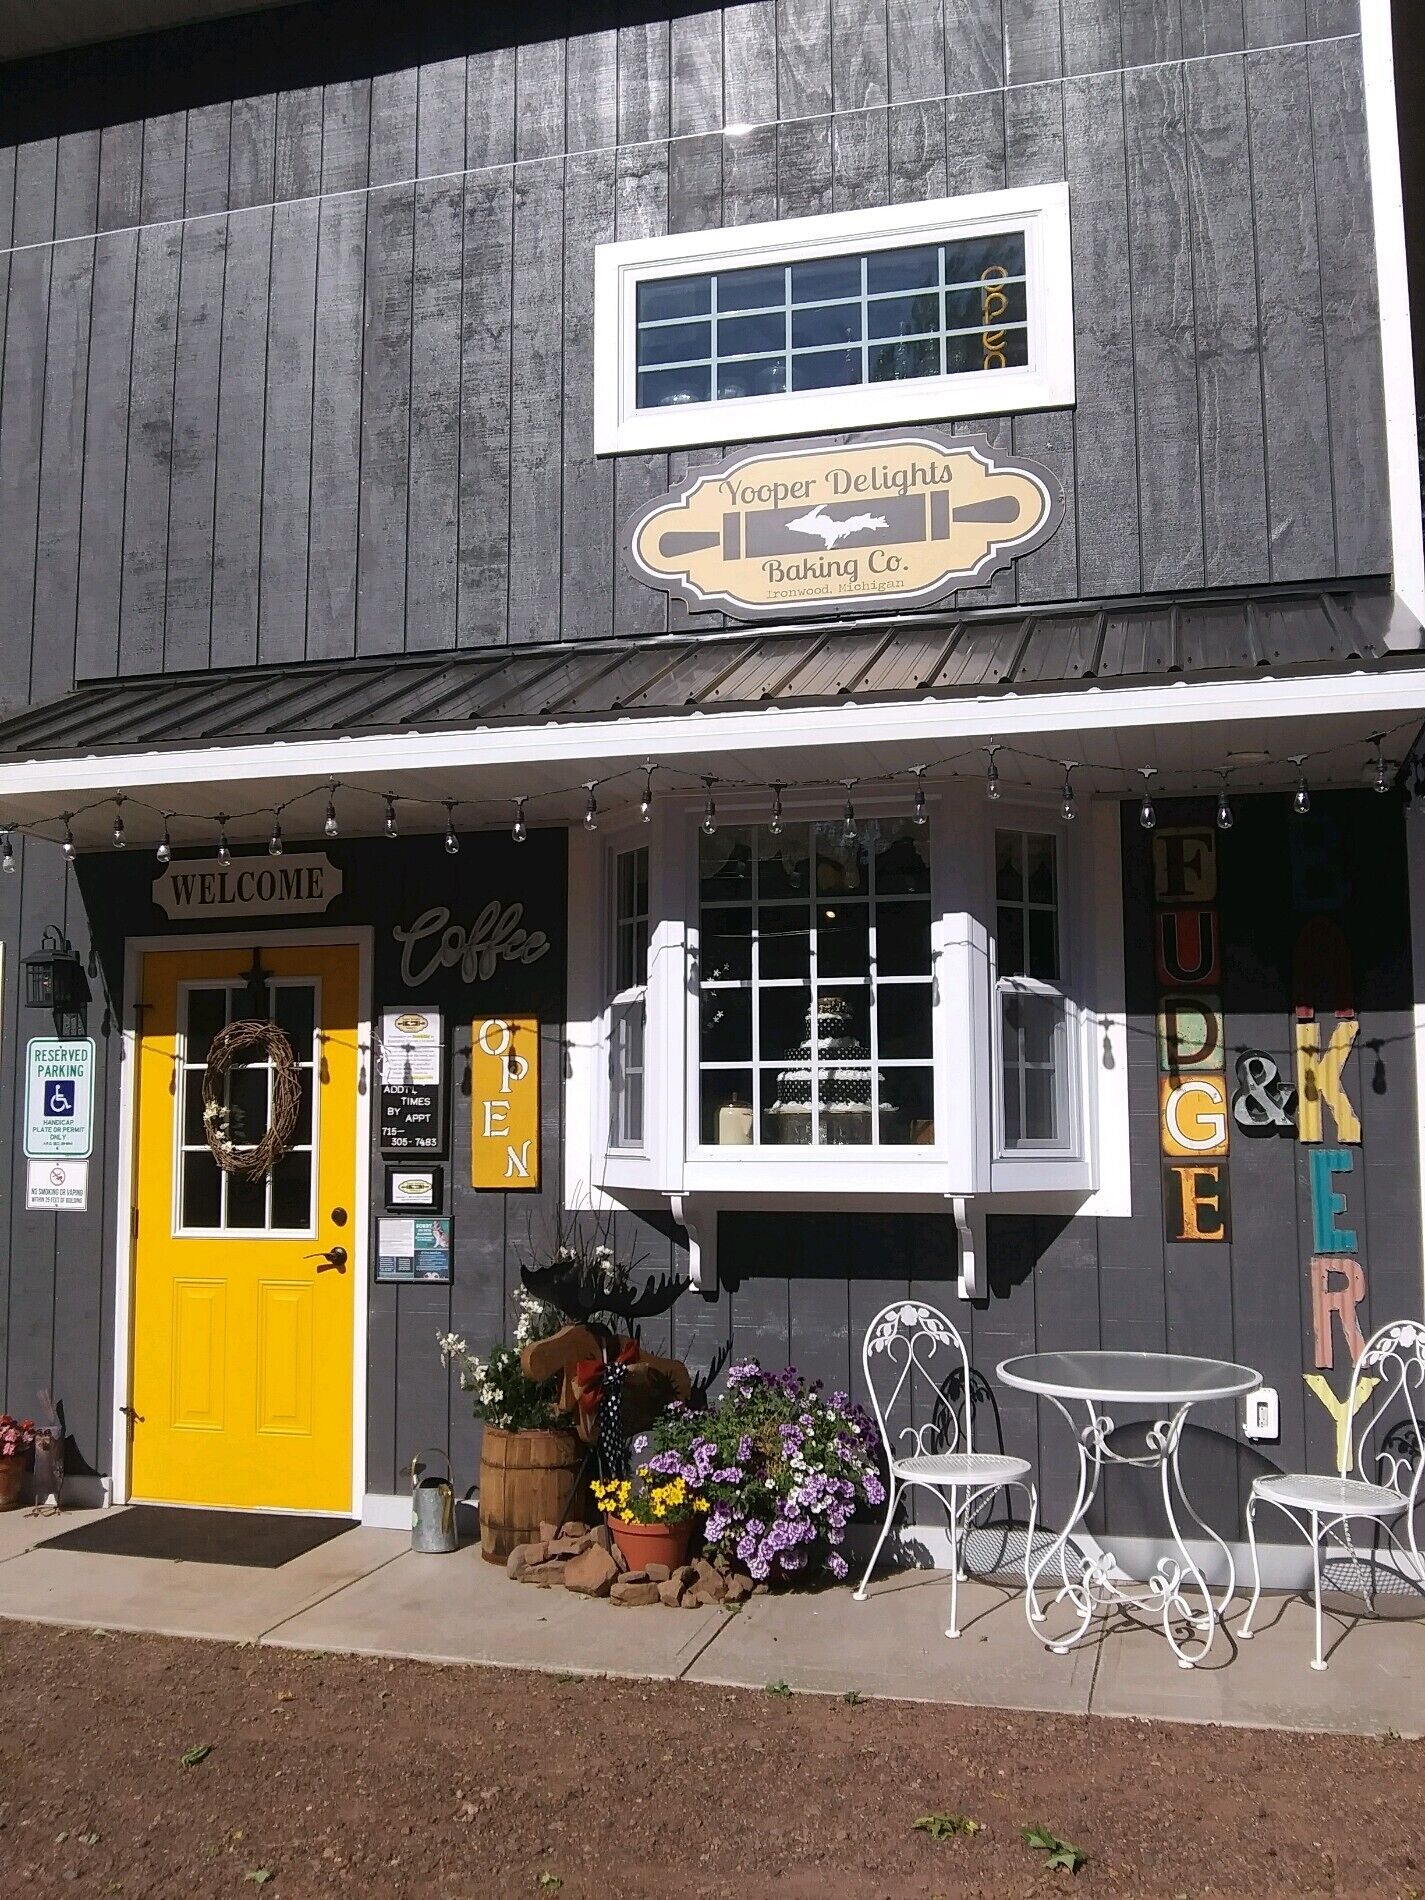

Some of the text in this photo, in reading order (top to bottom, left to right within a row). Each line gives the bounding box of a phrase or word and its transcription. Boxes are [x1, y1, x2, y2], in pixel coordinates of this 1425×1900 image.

[718, 461, 953, 509] Yooper Delights
[761, 549, 909, 583] Baking Co.
[766, 579, 905, 599] Ironwood, Michigan
[171, 867, 324, 906] WELCOME
[393, 900, 551, 988] Coffee
[1157, 834, 1227, 1241] FUDGE
[34, 1049, 88, 1062] RESERVED
[37, 1064, 84, 1078] PARKING
[400, 1097, 431, 1106] TIMES
[479, 1018, 533, 1178] OPEN
[1231, 1049, 1298, 1139] &
[387, 1107, 401, 1116] BY
[405, 1114, 431, 1123] APPT
[49, 1133, 67, 1141] ONLY
